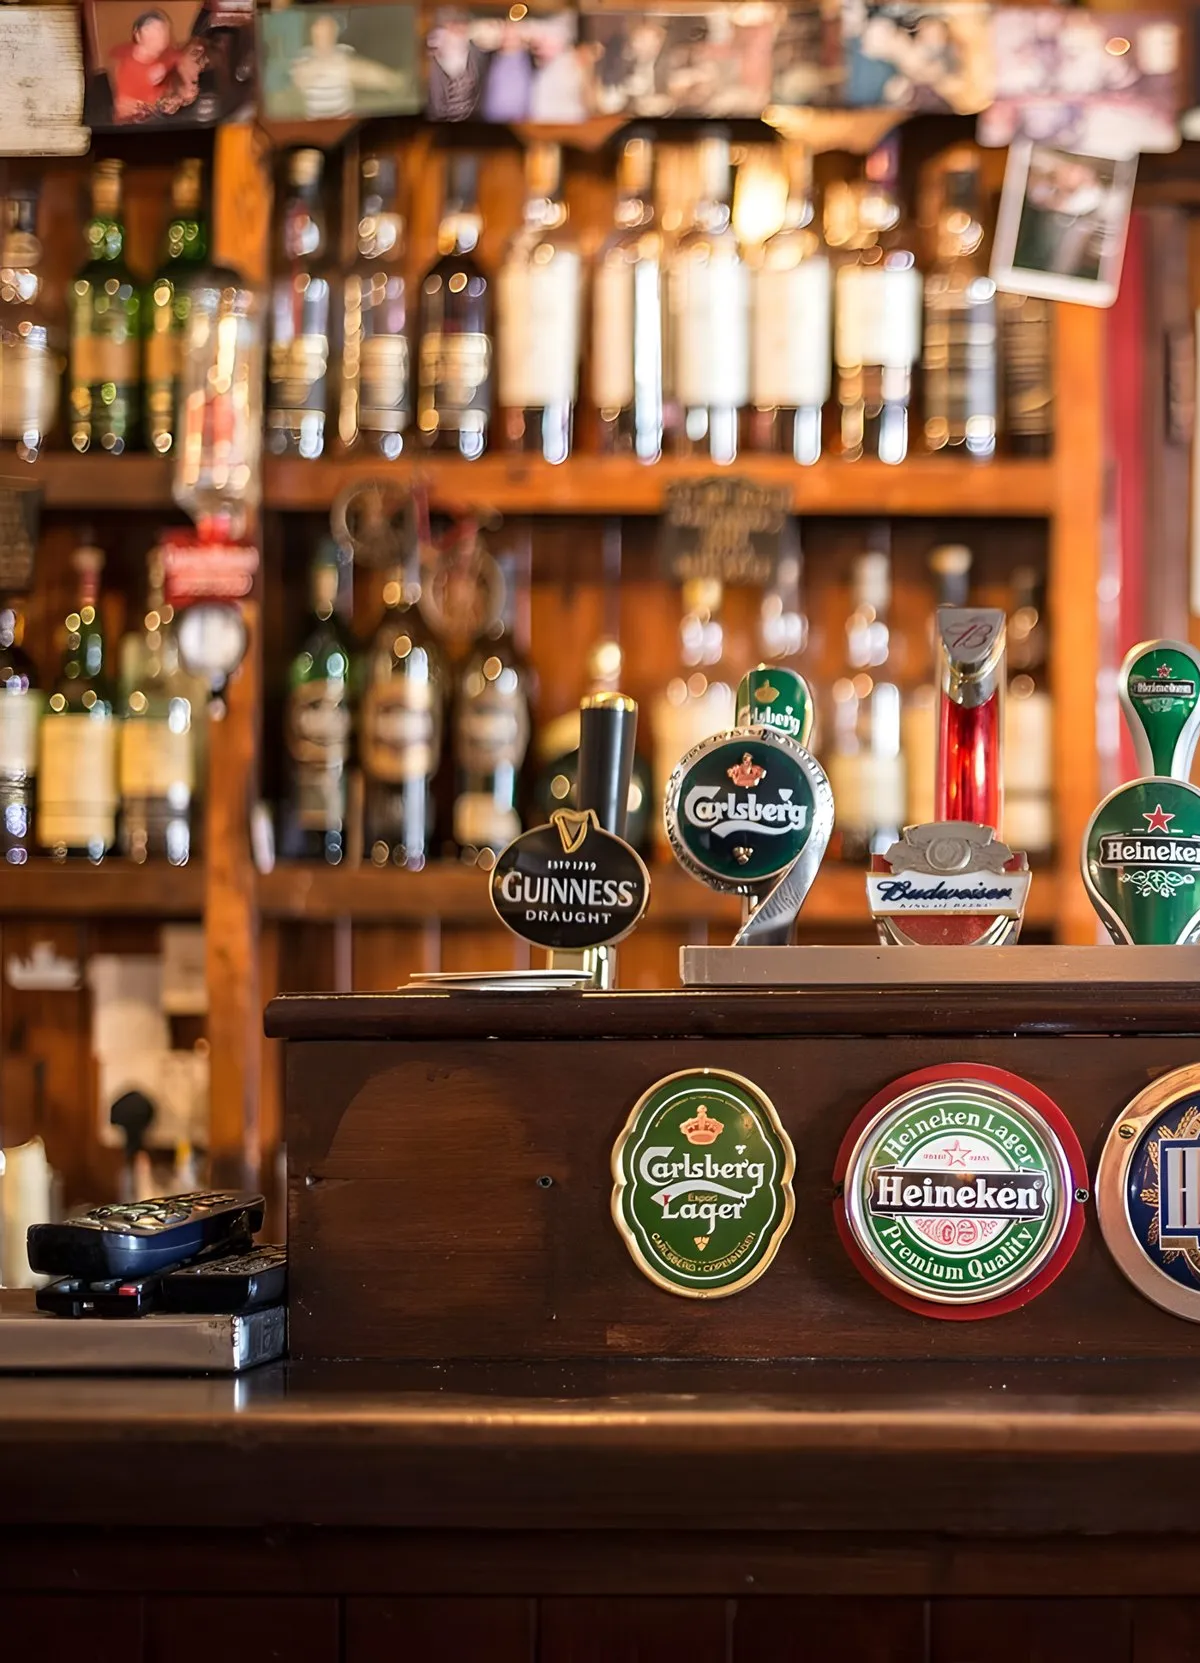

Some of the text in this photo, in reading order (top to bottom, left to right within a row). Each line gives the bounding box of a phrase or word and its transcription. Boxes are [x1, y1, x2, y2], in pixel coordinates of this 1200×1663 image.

[685, 786, 808, 836] Carlsberg
[502, 871, 635, 907] GUINNESS
[876, 880, 1013, 902] Budweiser
[525, 909, 612, 924] DRAUGHT
[882, 1108, 1036, 1164] Heineken Lager
[639, 1145, 766, 1192] Carlsberg
[877, 1176, 1040, 1210] Heineken
[661, 1196, 747, 1235] Lager
[882, 1225, 1036, 1280] Premium Quality
